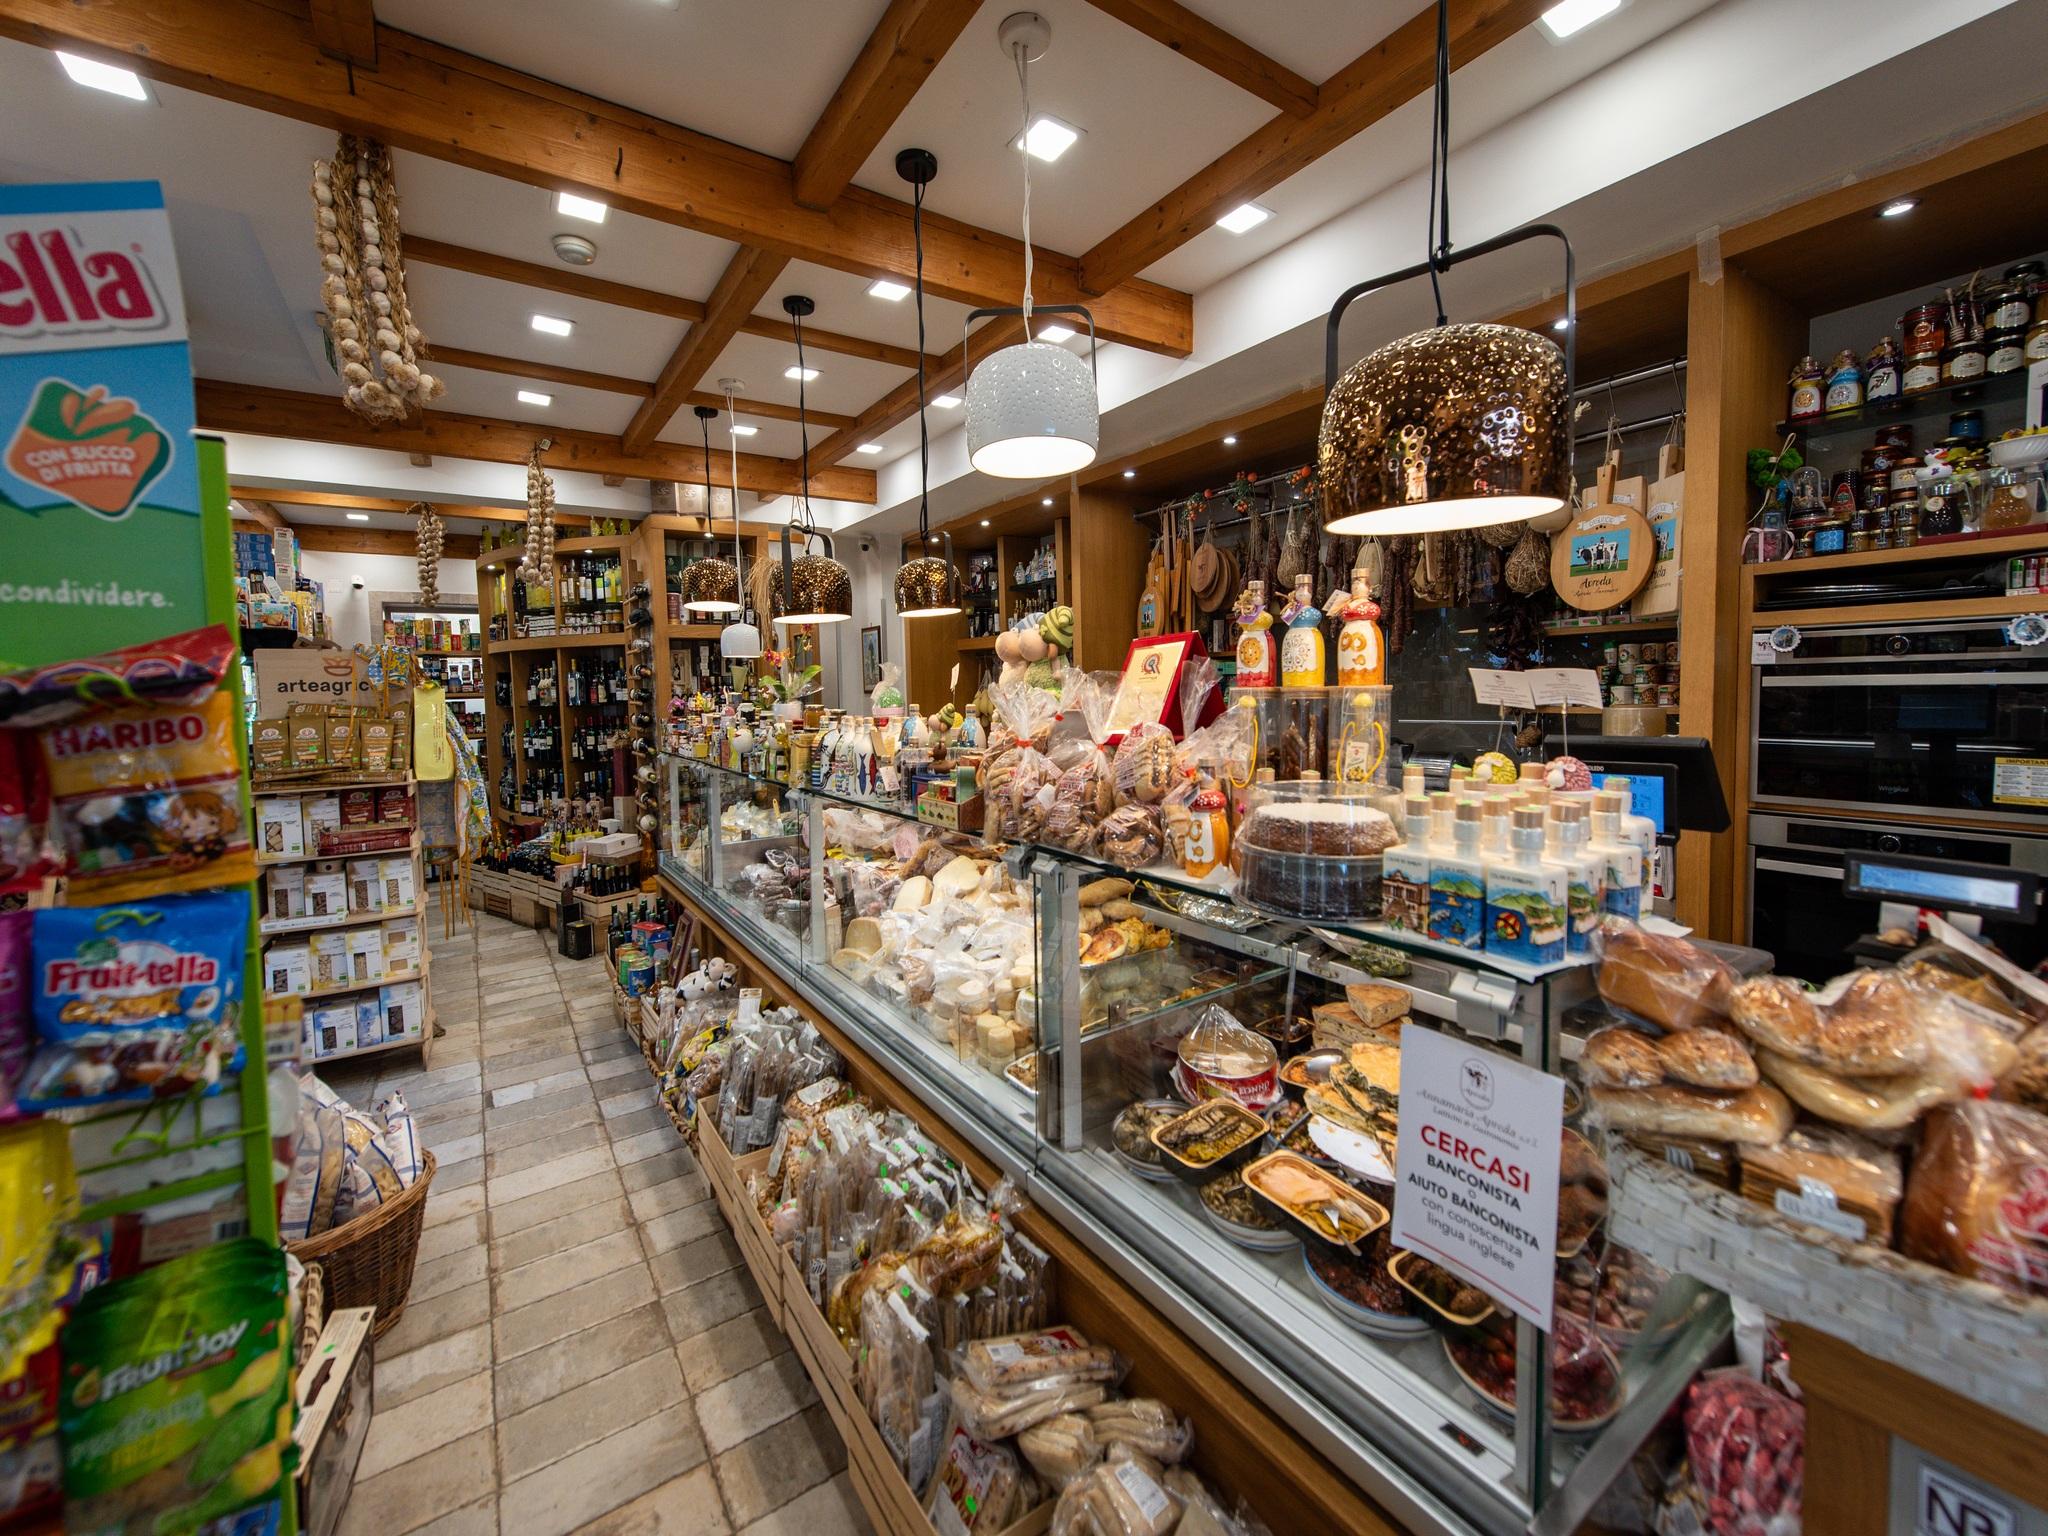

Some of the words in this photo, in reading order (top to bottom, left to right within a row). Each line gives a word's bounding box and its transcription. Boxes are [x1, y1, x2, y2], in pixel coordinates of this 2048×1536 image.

[25, 447, 68, 467] CON
[69, 444, 136, 461] SUCCO
[39, 466, 63, 482] DI
[62, 461, 132, 477] FRUTTA
[0, 578, 174, 608] condividere.
[53, 716, 204, 756] HARIBO
[48, 954, 216, 993] Fruit-tella
[1420, 1125, 1530, 1194] CERCASI
[1427, 1153, 1522, 1212] BANCONISTA
[1408, 1172, 1448, 1200] AIUTO
[1451, 1192, 1541, 1251] BANCONISTA
[1421, 1196, 1445, 1215] con
[1448, 1211, 1523, 1259] conoscenza
[1427, 1211, 1465, 1243] lingua
[1469, 1233, 1515, 1271] inglese
